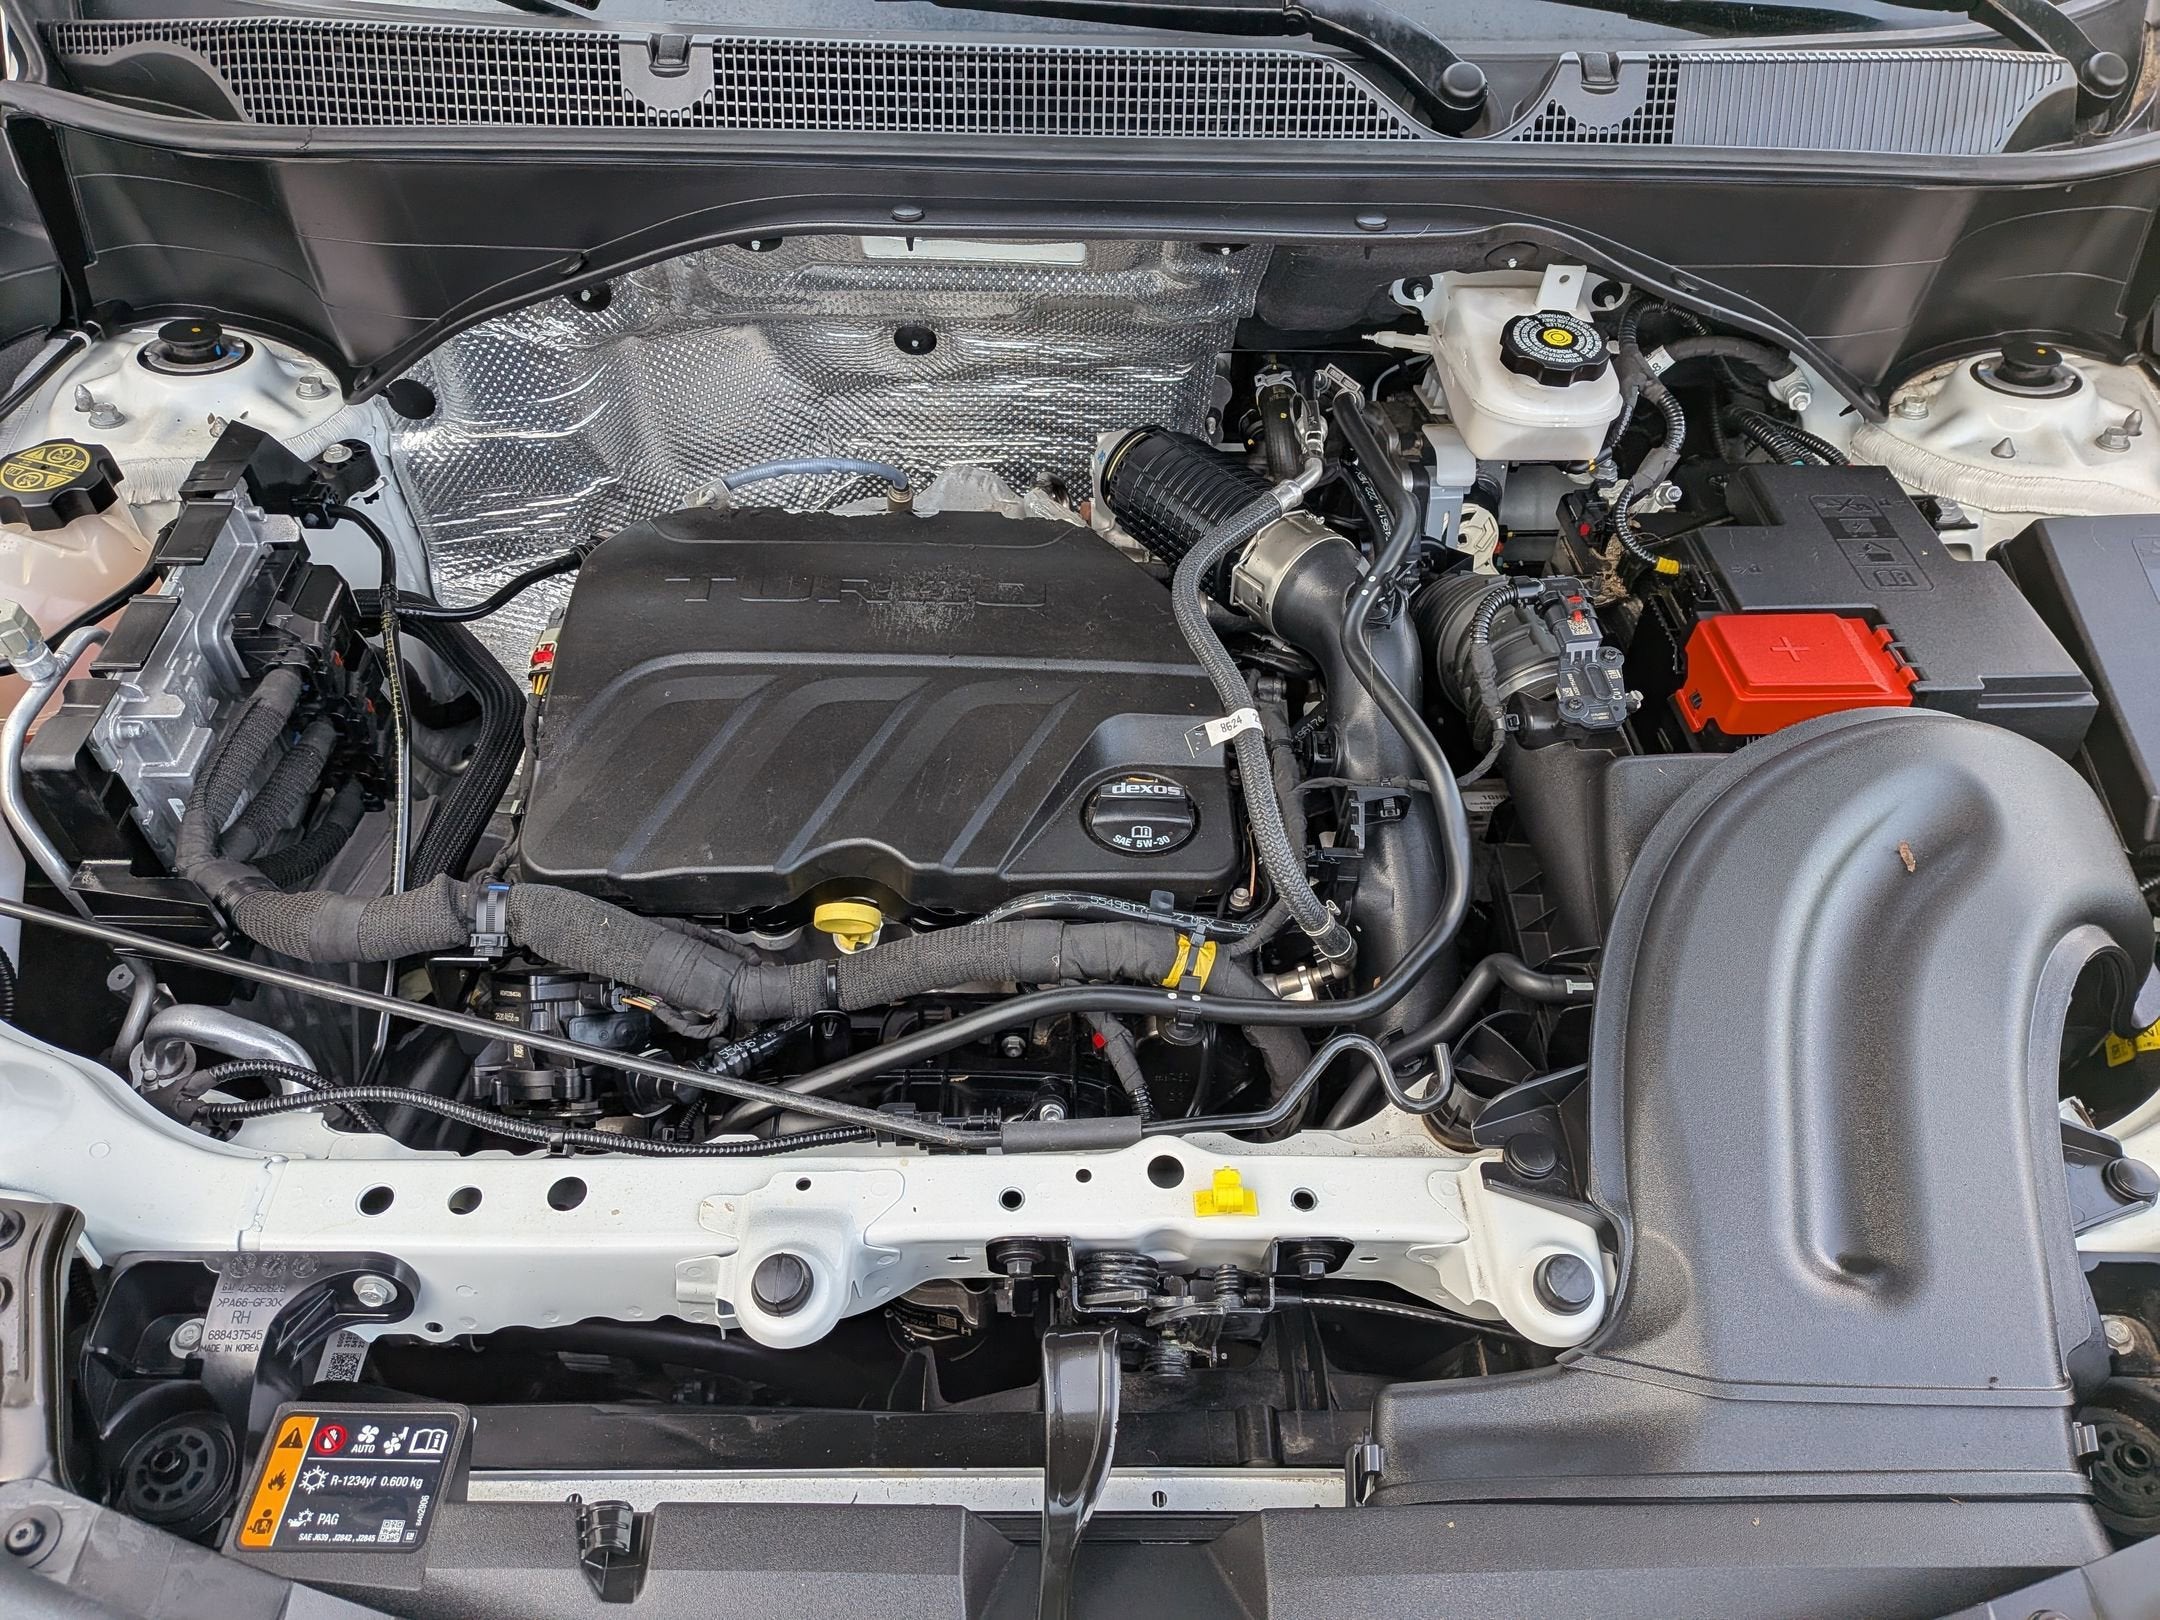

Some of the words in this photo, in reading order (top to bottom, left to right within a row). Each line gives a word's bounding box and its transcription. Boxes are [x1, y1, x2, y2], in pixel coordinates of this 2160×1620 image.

[664, 578, 1047, 607] TURBO
[1220, 715, 1243, 733] 8624
[1112, 782, 1182, 796] dexos
[1113, 835, 1132, 847] SAE
[1136, 835, 1171, 848] 5W-30
[216, 1297, 284, 1308] >PA66-GF30<
[231, 1310, 252, 1325] RH
[207, 1329, 264, 1341] 688437545
[200, 1343, 220, 1353] MADE
[224, 1344, 233, 1353] IN
[235, 1343, 260, 1353] KOREA
[350, 1443, 376, 1454] AUTO
[330, 1474, 377, 1489] R-1234yf
[380, 1475, 409, 1487] 0.600
[409, 1476, 424, 1490] kg
[316, 1512, 340, 1525] PAG
[298, 1532, 313, 1542] SAE
[355, 1533, 377, 1543] J2845
